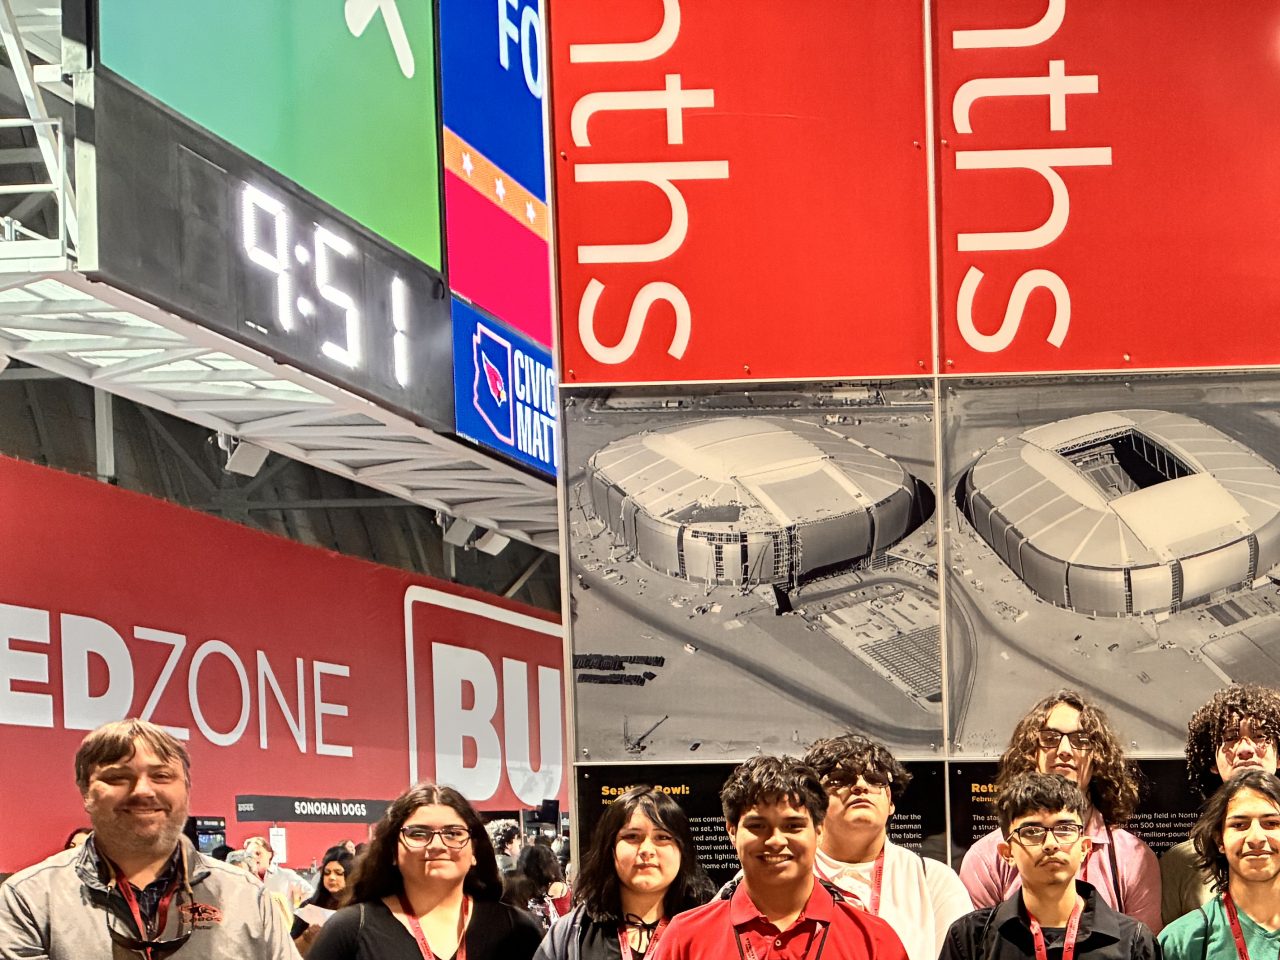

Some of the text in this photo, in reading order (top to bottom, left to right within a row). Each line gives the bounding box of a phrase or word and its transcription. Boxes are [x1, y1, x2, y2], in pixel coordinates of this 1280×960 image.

[242, 180, 408, 388] 9:51
[654, 784, 690, 795] Bowl:
[294, 801, 367, 816] SONORAN DOGS
[714, 852, 739, 861] lighting
